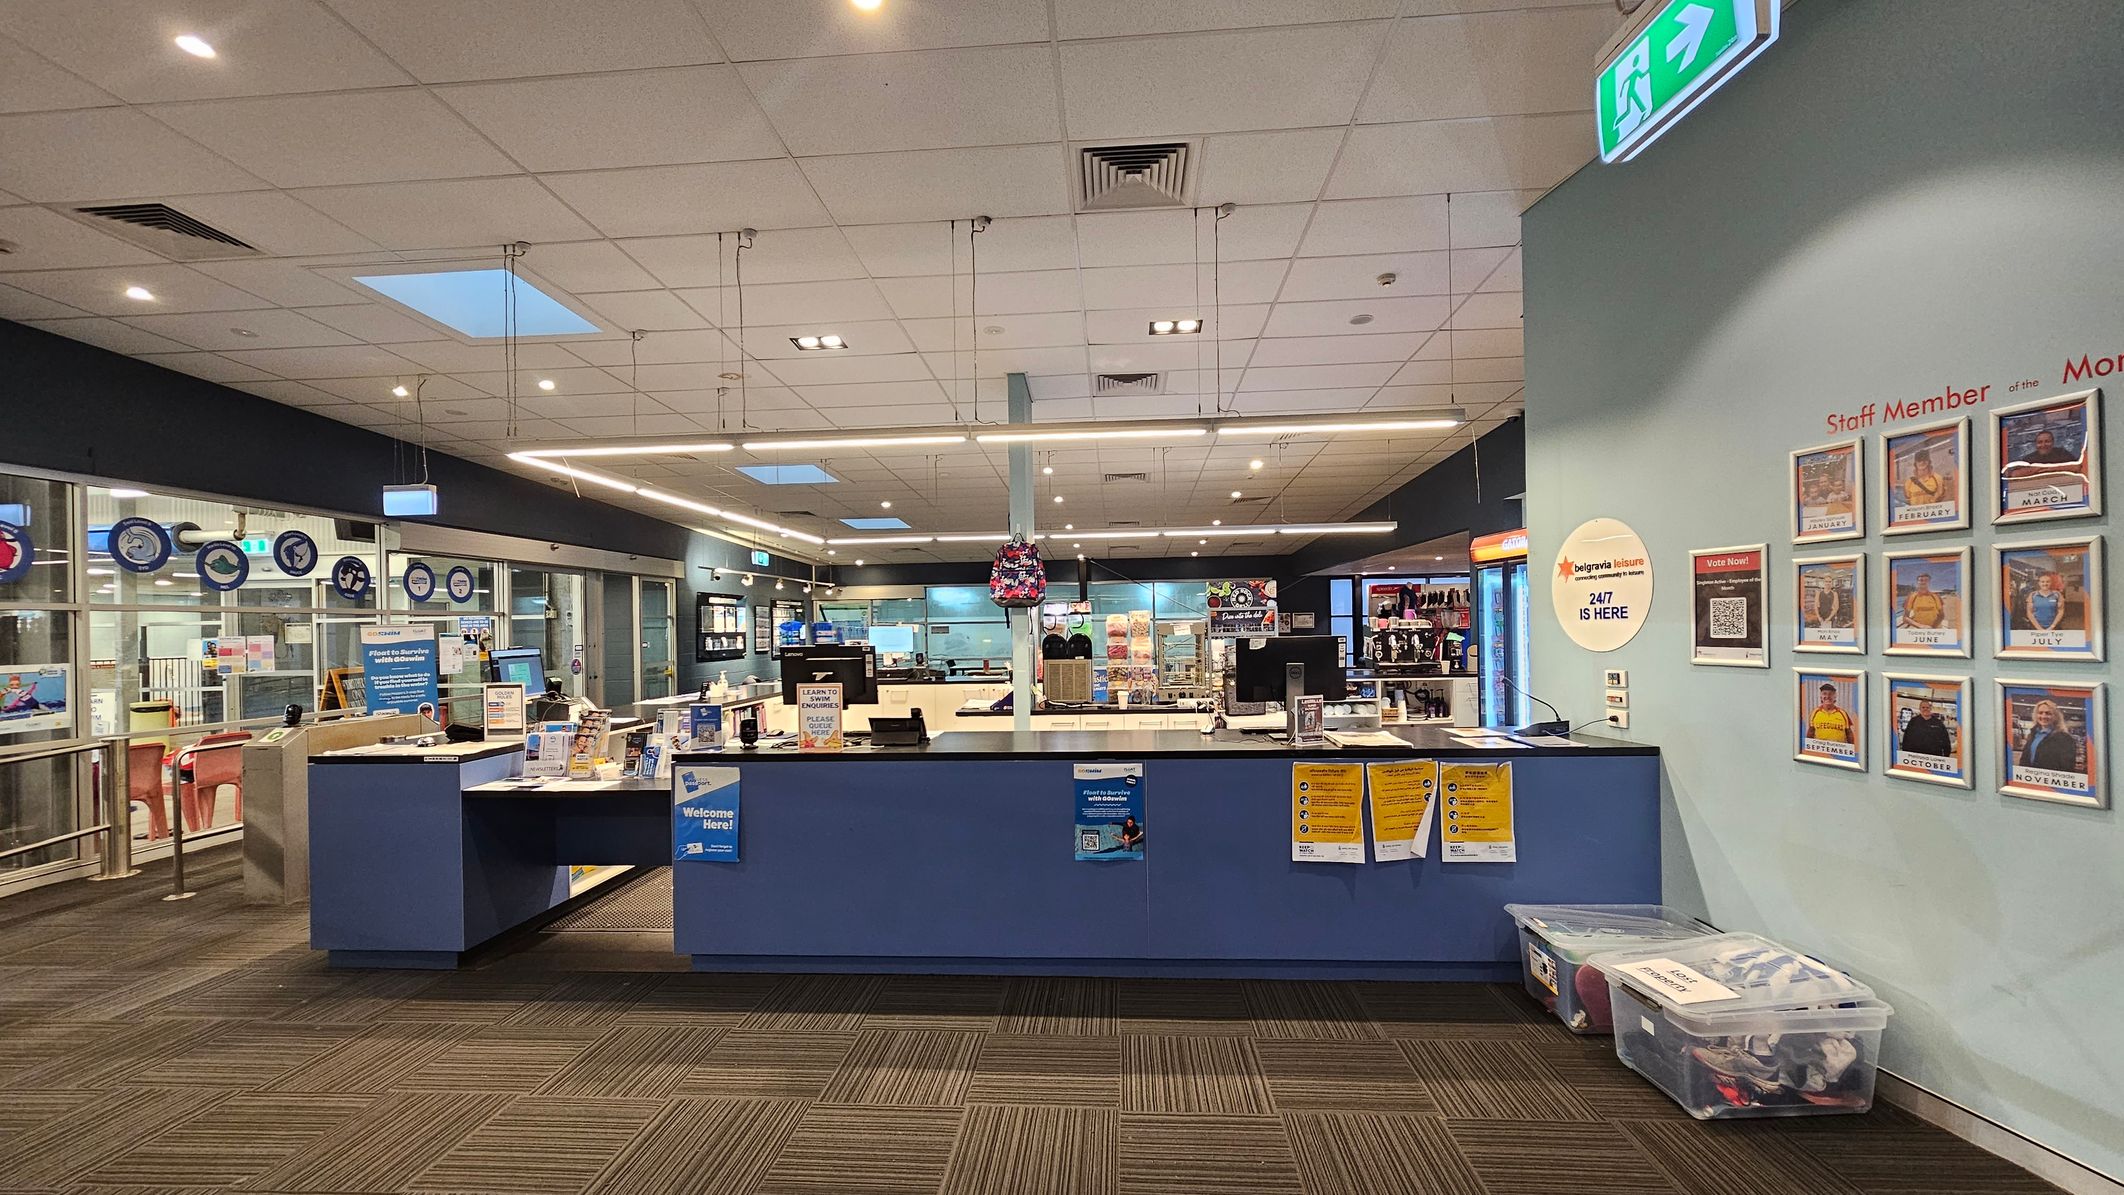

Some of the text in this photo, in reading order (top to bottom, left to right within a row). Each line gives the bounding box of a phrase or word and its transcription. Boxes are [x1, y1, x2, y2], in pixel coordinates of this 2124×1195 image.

[1826, 403, 1875, 435] Staff
[1883, 385, 1991, 423] Member
[2009, 381, 2019, 392] of
[2022, 379, 2039, 390] the
[2022, 495, 2068, 506] MARCH
[1898, 509, 1950, 520] FEBRUARY
[1808, 520, 1847, 530] JANUARY
[1574, 558, 1644, 573] belgravia leisure
[1707, 556, 1749, 568] Vote Now!
[1598, 571, 1622, 579] community
[1589, 591, 1613, 605] 24/7
[1580, 606, 1629, 620] IS HERE
[369, 649, 390, 657] Float
[375, 656, 394, 664] with
[1806, 744, 1854, 755] SEPTEMBER
[1903, 758, 1951, 770] OCTOBER
[2016, 774, 2086, 790] NOVEMBER
[683, 807, 734, 819] Welcome
[703, 819, 733, 830] Here!
[1640, 966, 1688, 993] Property
[1670, 969, 1698, 984] Lost
